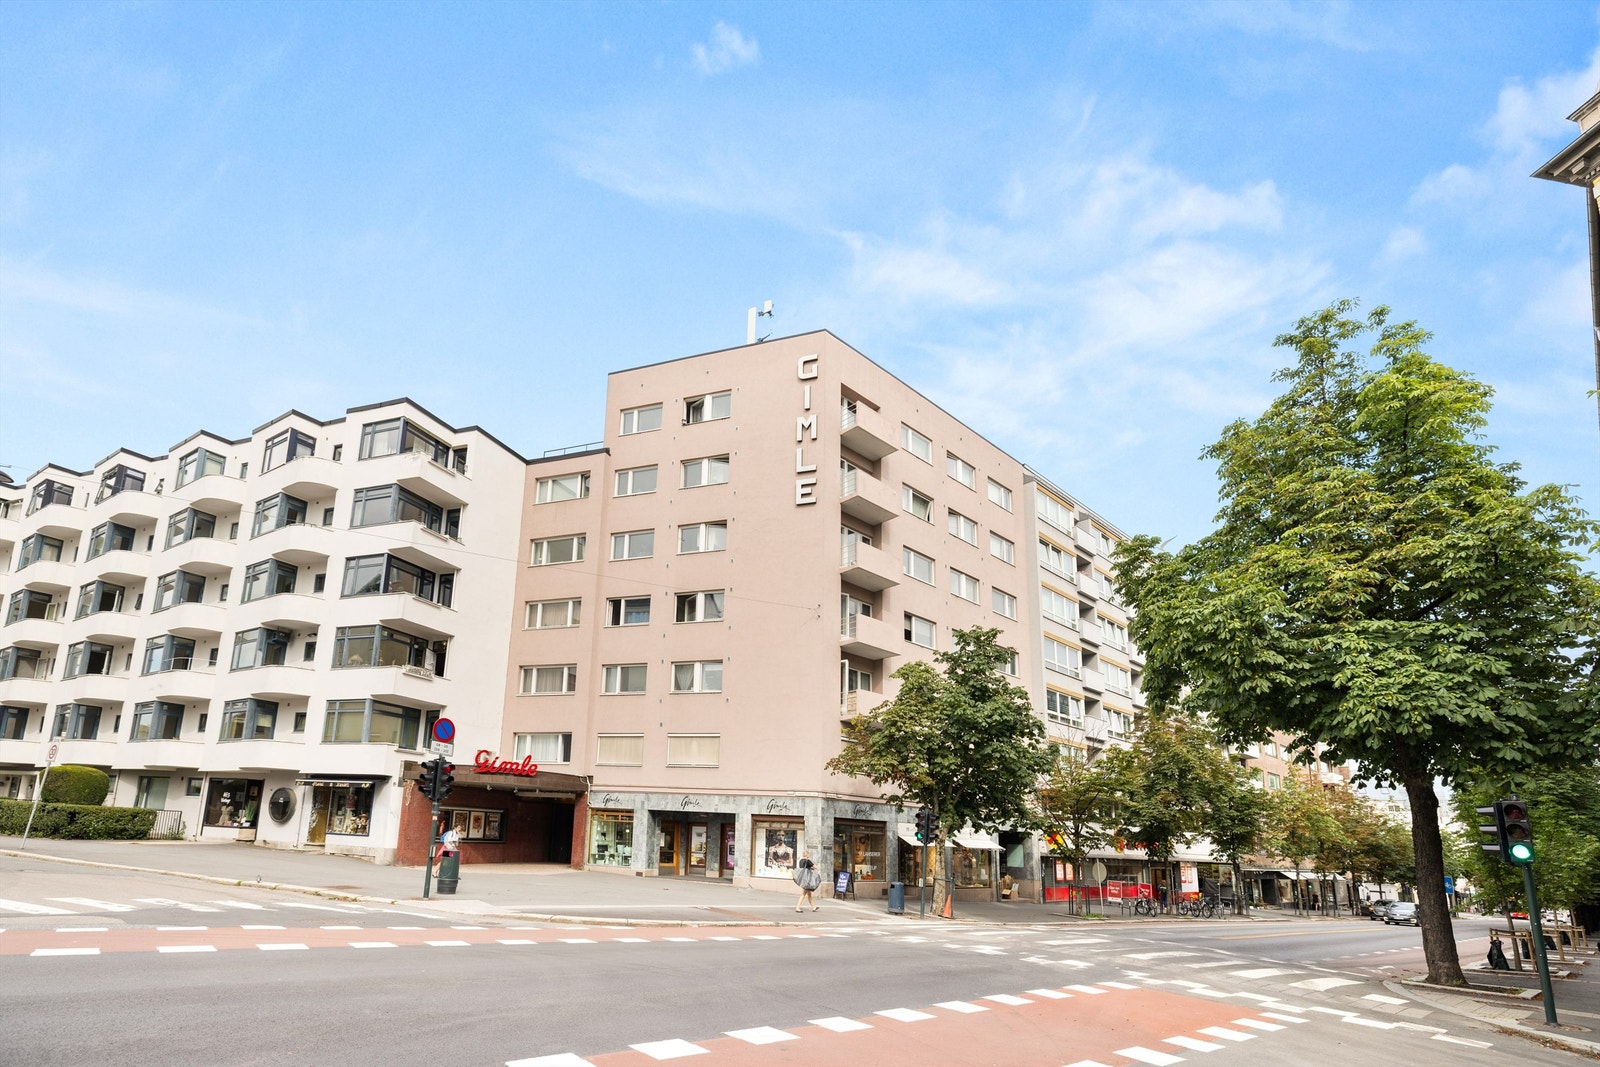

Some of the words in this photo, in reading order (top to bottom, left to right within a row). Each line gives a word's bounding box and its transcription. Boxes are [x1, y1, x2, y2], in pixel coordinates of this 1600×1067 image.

[796, 353, 818, 505] GIMLE
[473, 749, 539, 777] Gimle
[680, 795, 703, 810] Gimle
[766, 798, 791, 813] Gimle
